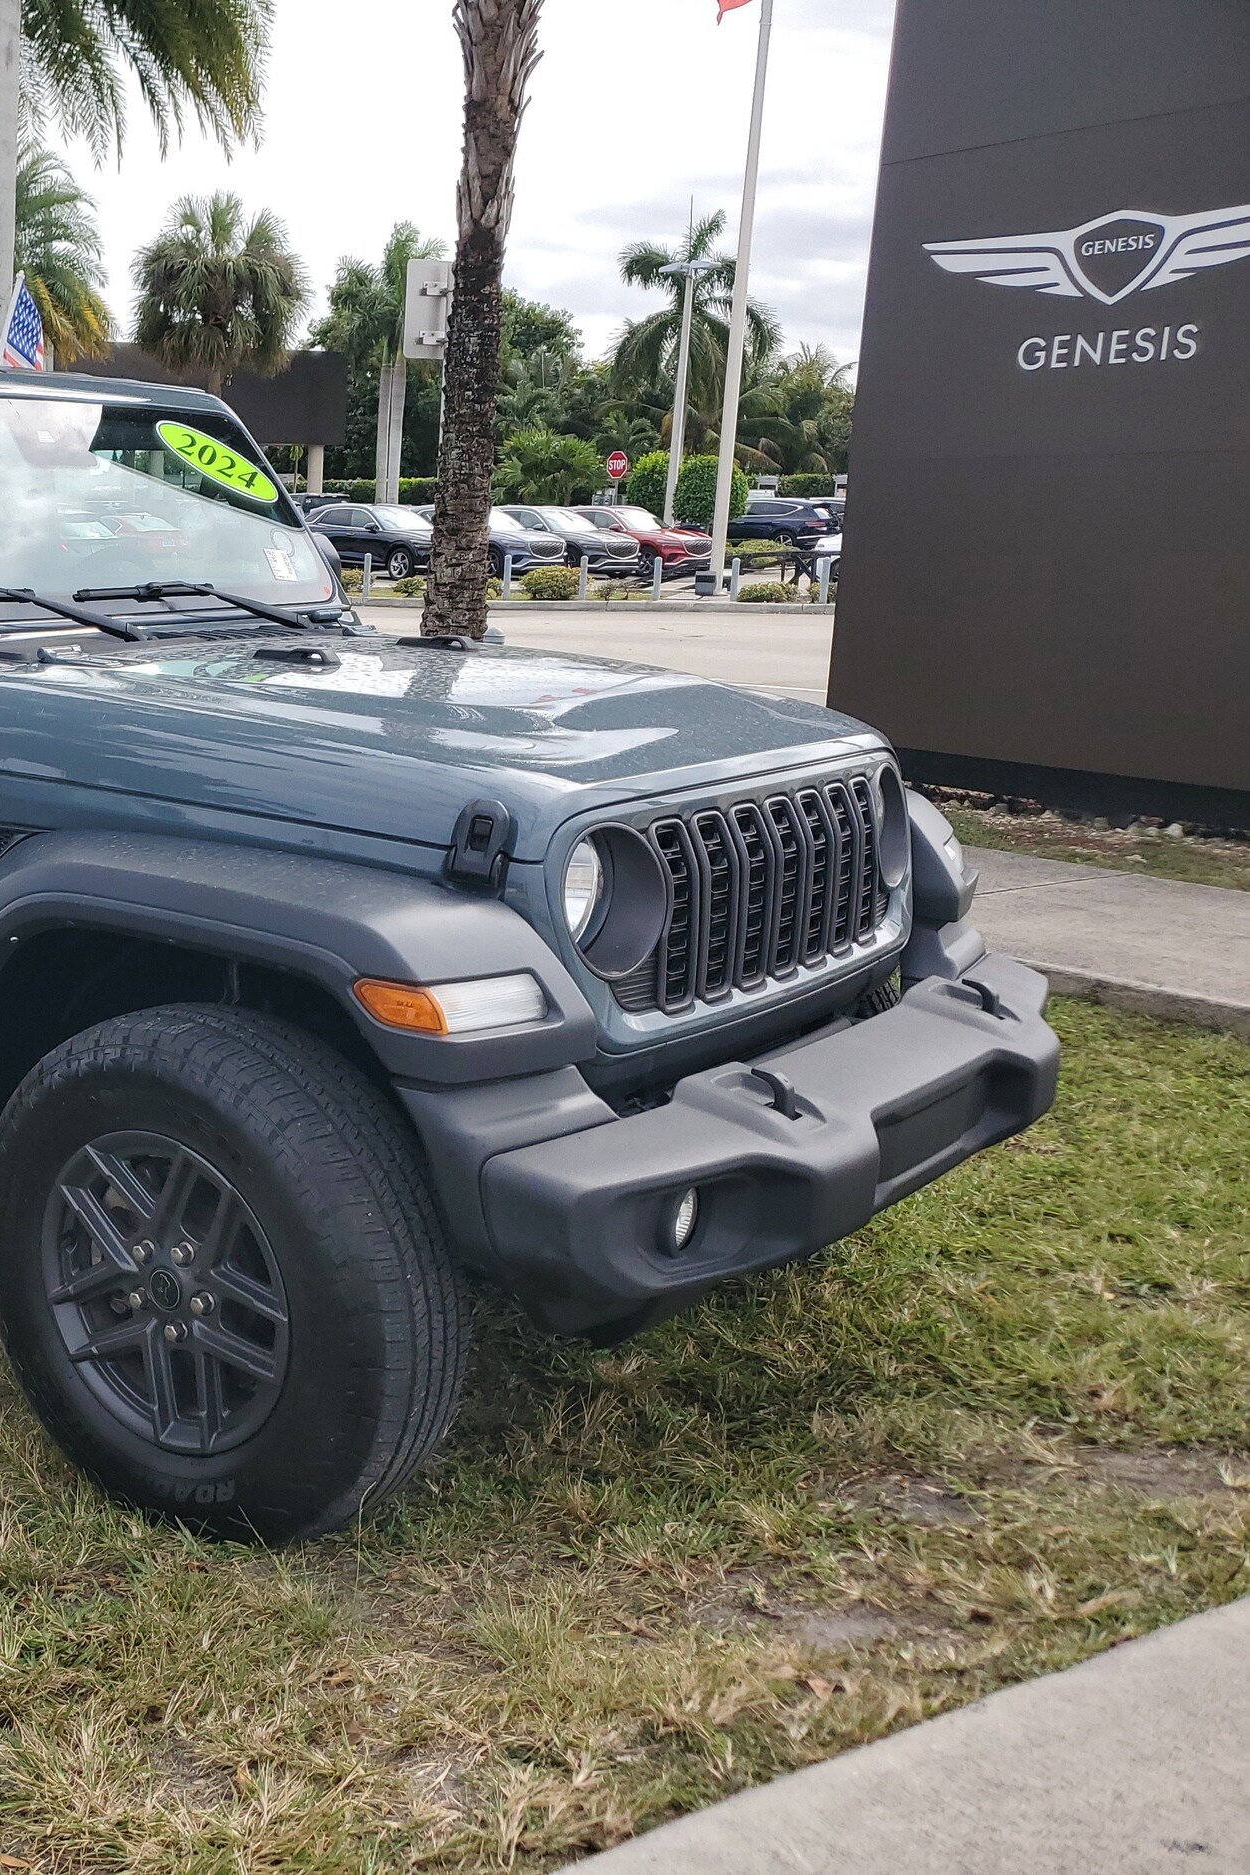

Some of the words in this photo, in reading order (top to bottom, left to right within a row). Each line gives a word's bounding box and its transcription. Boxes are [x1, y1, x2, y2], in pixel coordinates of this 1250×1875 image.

[1081, 234, 1155, 256] GENESIS
[1017, 324, 1199, 370] GENESIS
[176, 433, 258, 489] 2024
[608, 459, 626, 471] STOP
